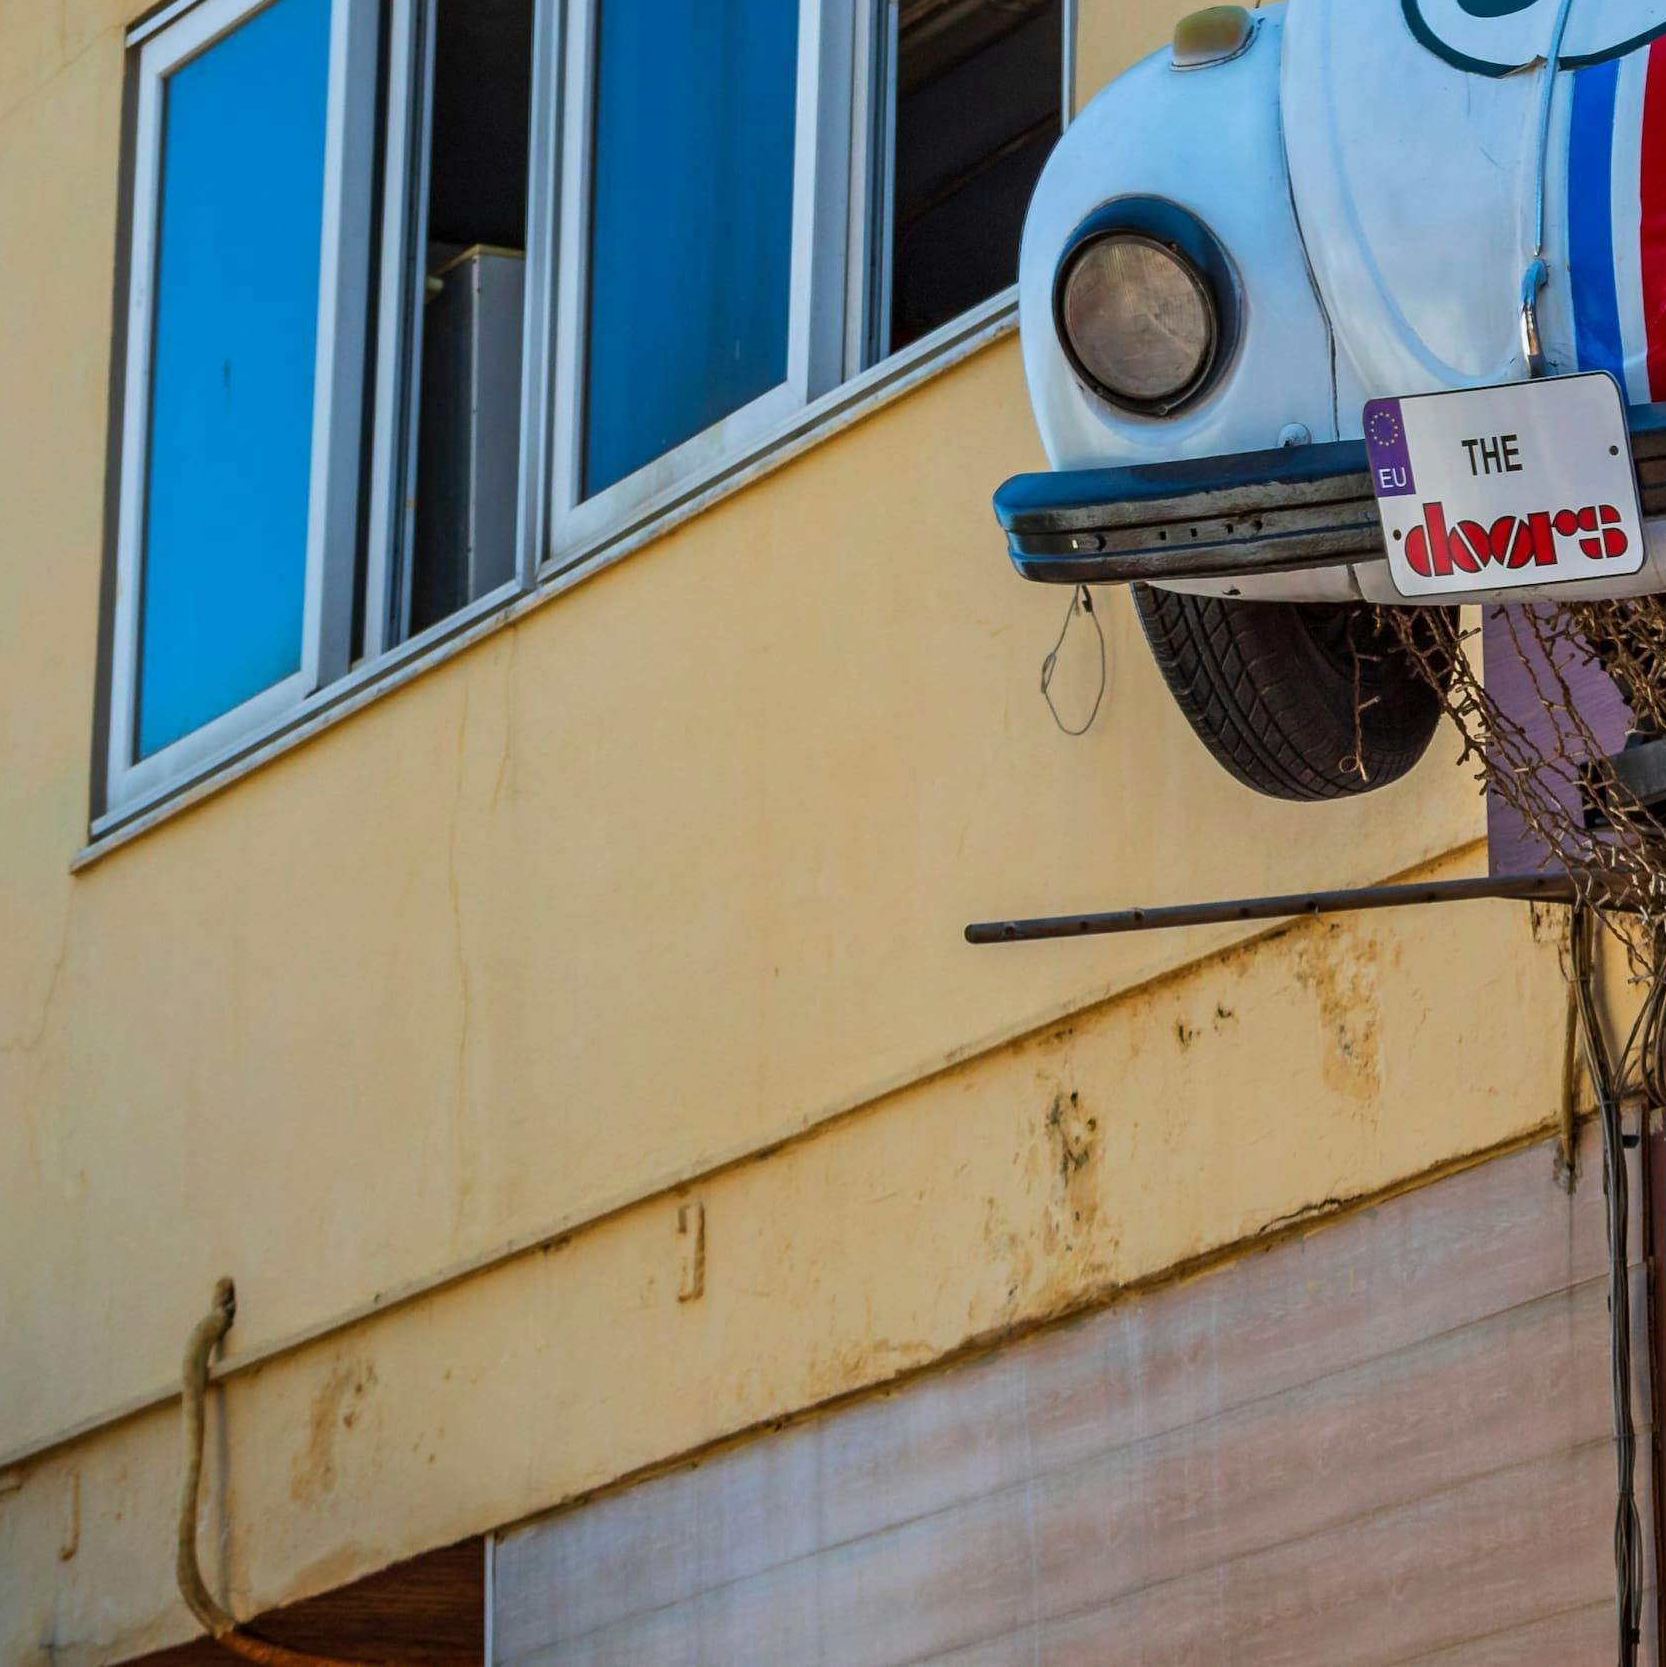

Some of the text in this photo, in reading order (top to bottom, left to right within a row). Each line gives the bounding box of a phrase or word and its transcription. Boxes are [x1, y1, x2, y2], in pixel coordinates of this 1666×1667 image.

[1461, 434, 1523, 477] THE
[1378, 466, 1408, 490] EU
[1404, 501, 1629, 578] doors
